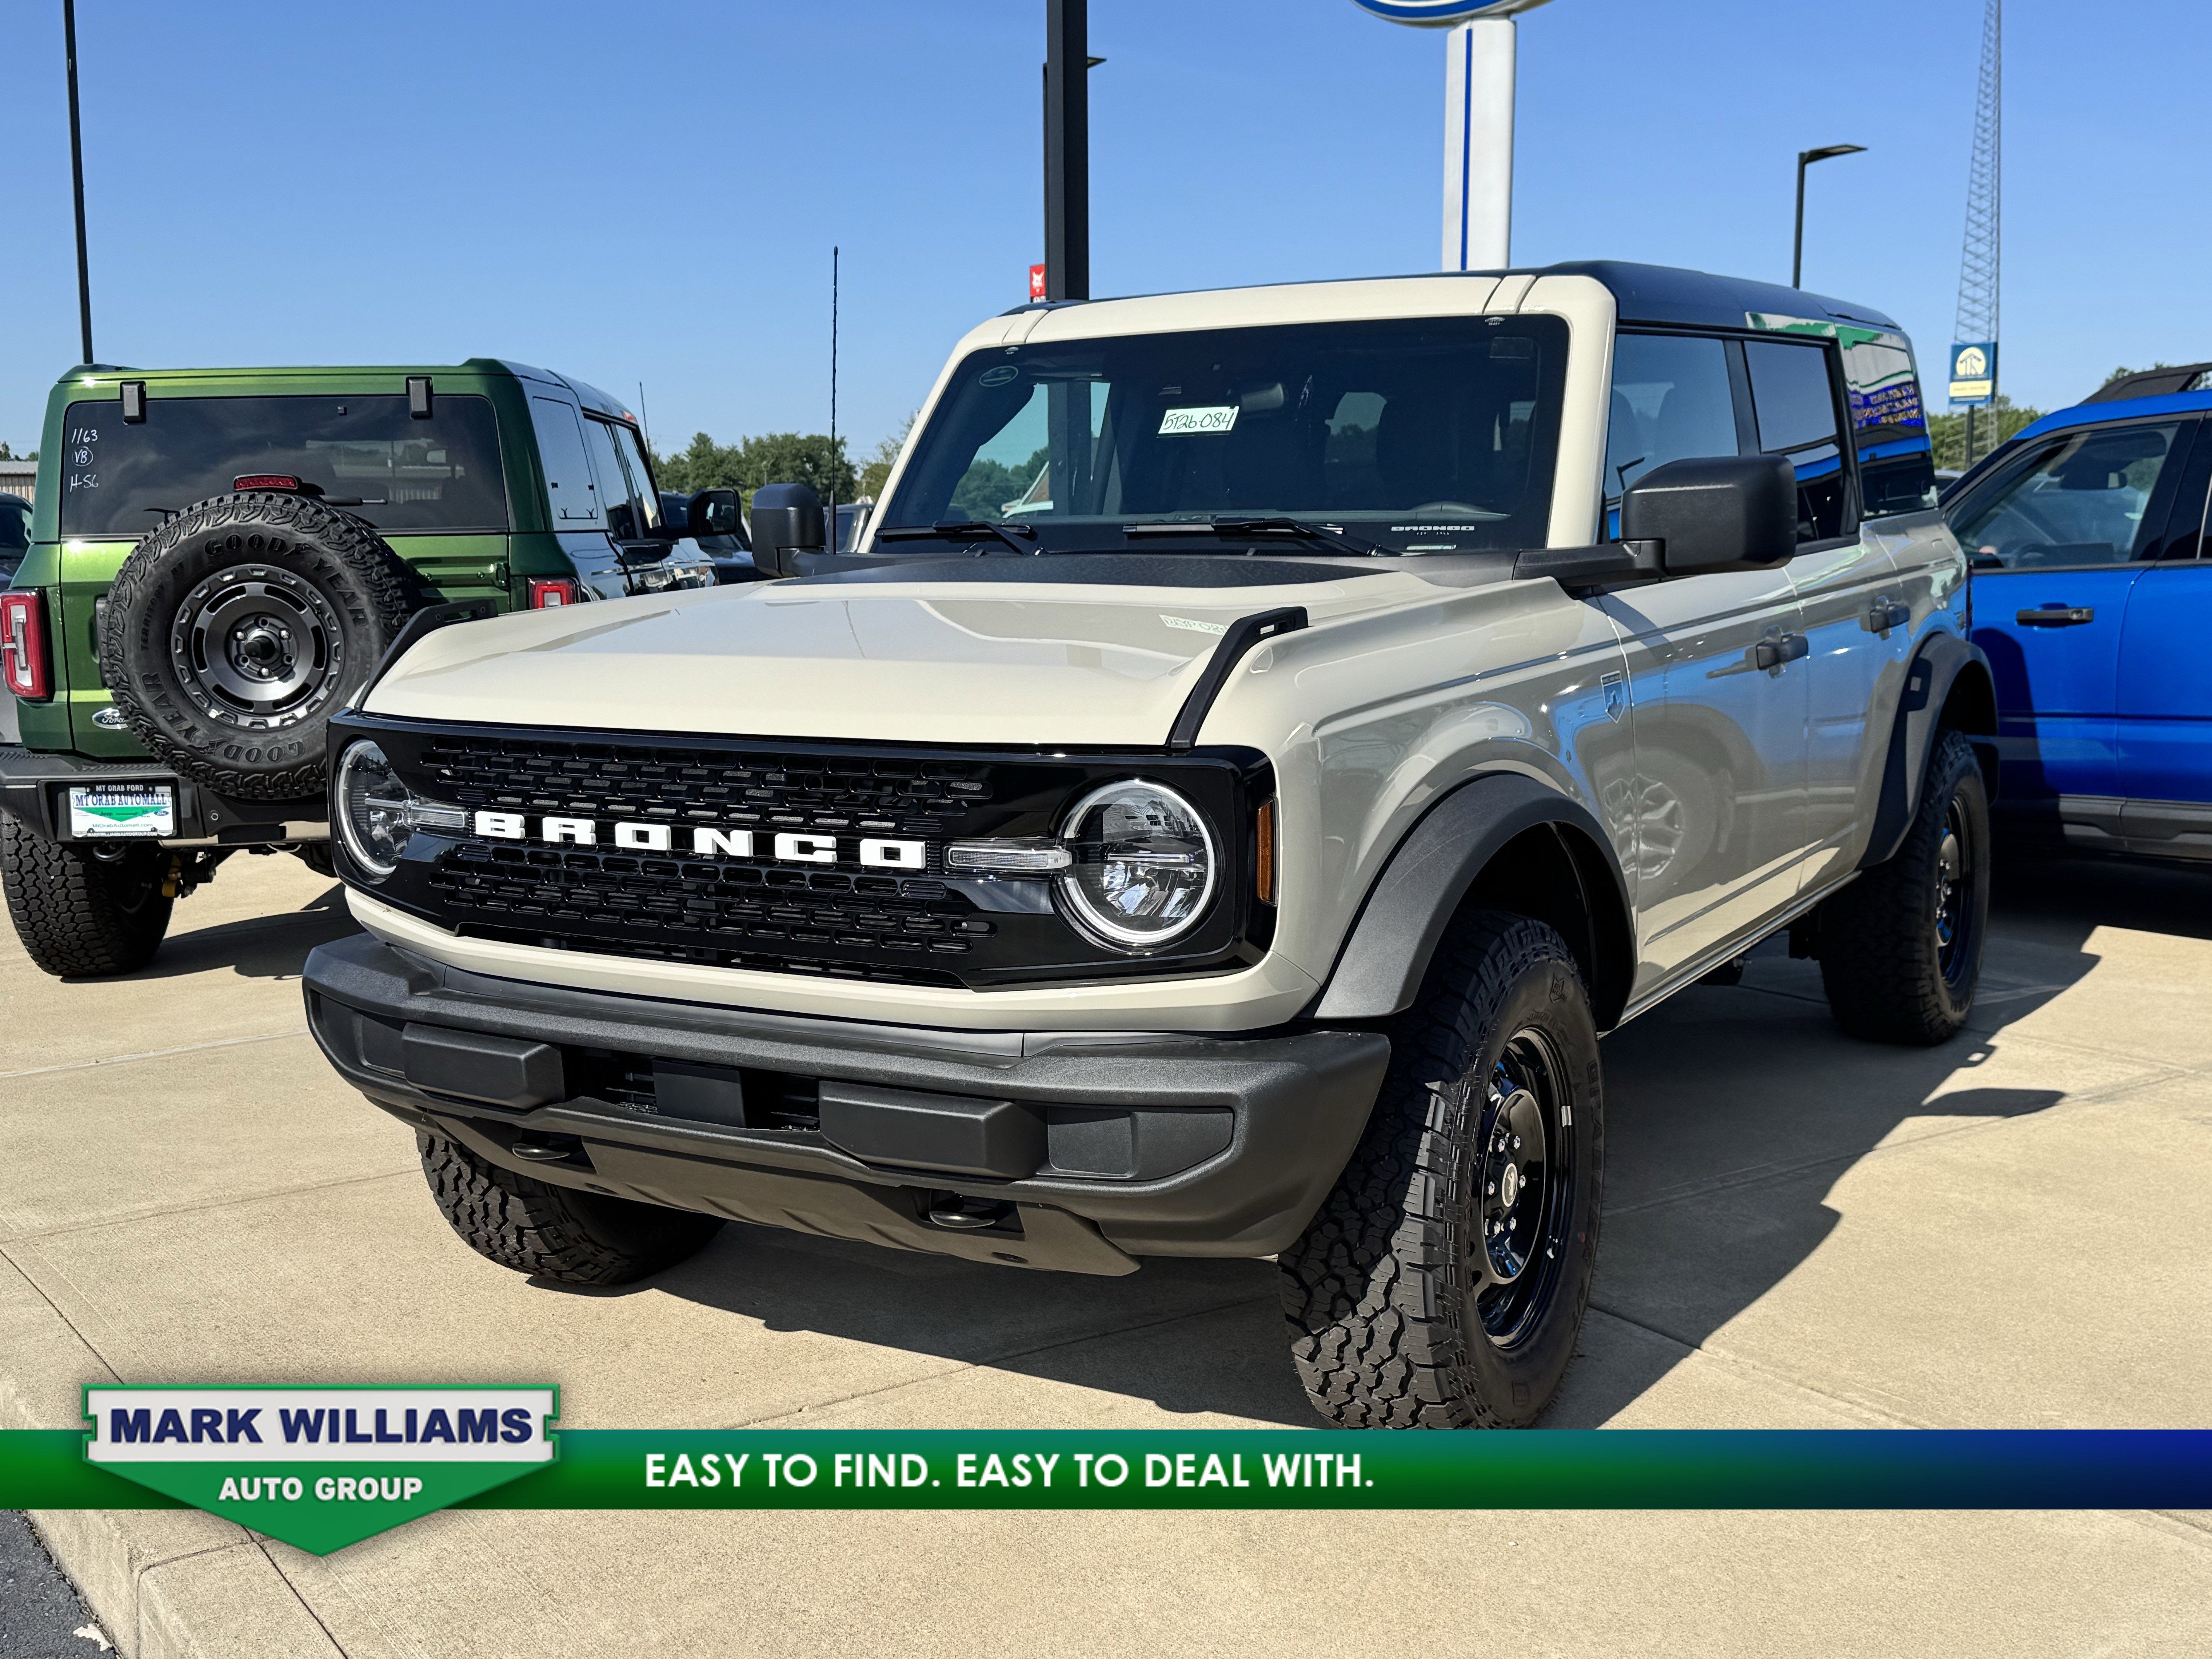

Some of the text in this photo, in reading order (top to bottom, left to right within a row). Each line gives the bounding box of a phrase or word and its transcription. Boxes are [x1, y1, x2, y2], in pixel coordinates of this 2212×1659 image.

[75, 795, 89, 806] MT
[91, 794, 116, 806] ORAB
[475, 811, 926, 869] BRONCO
